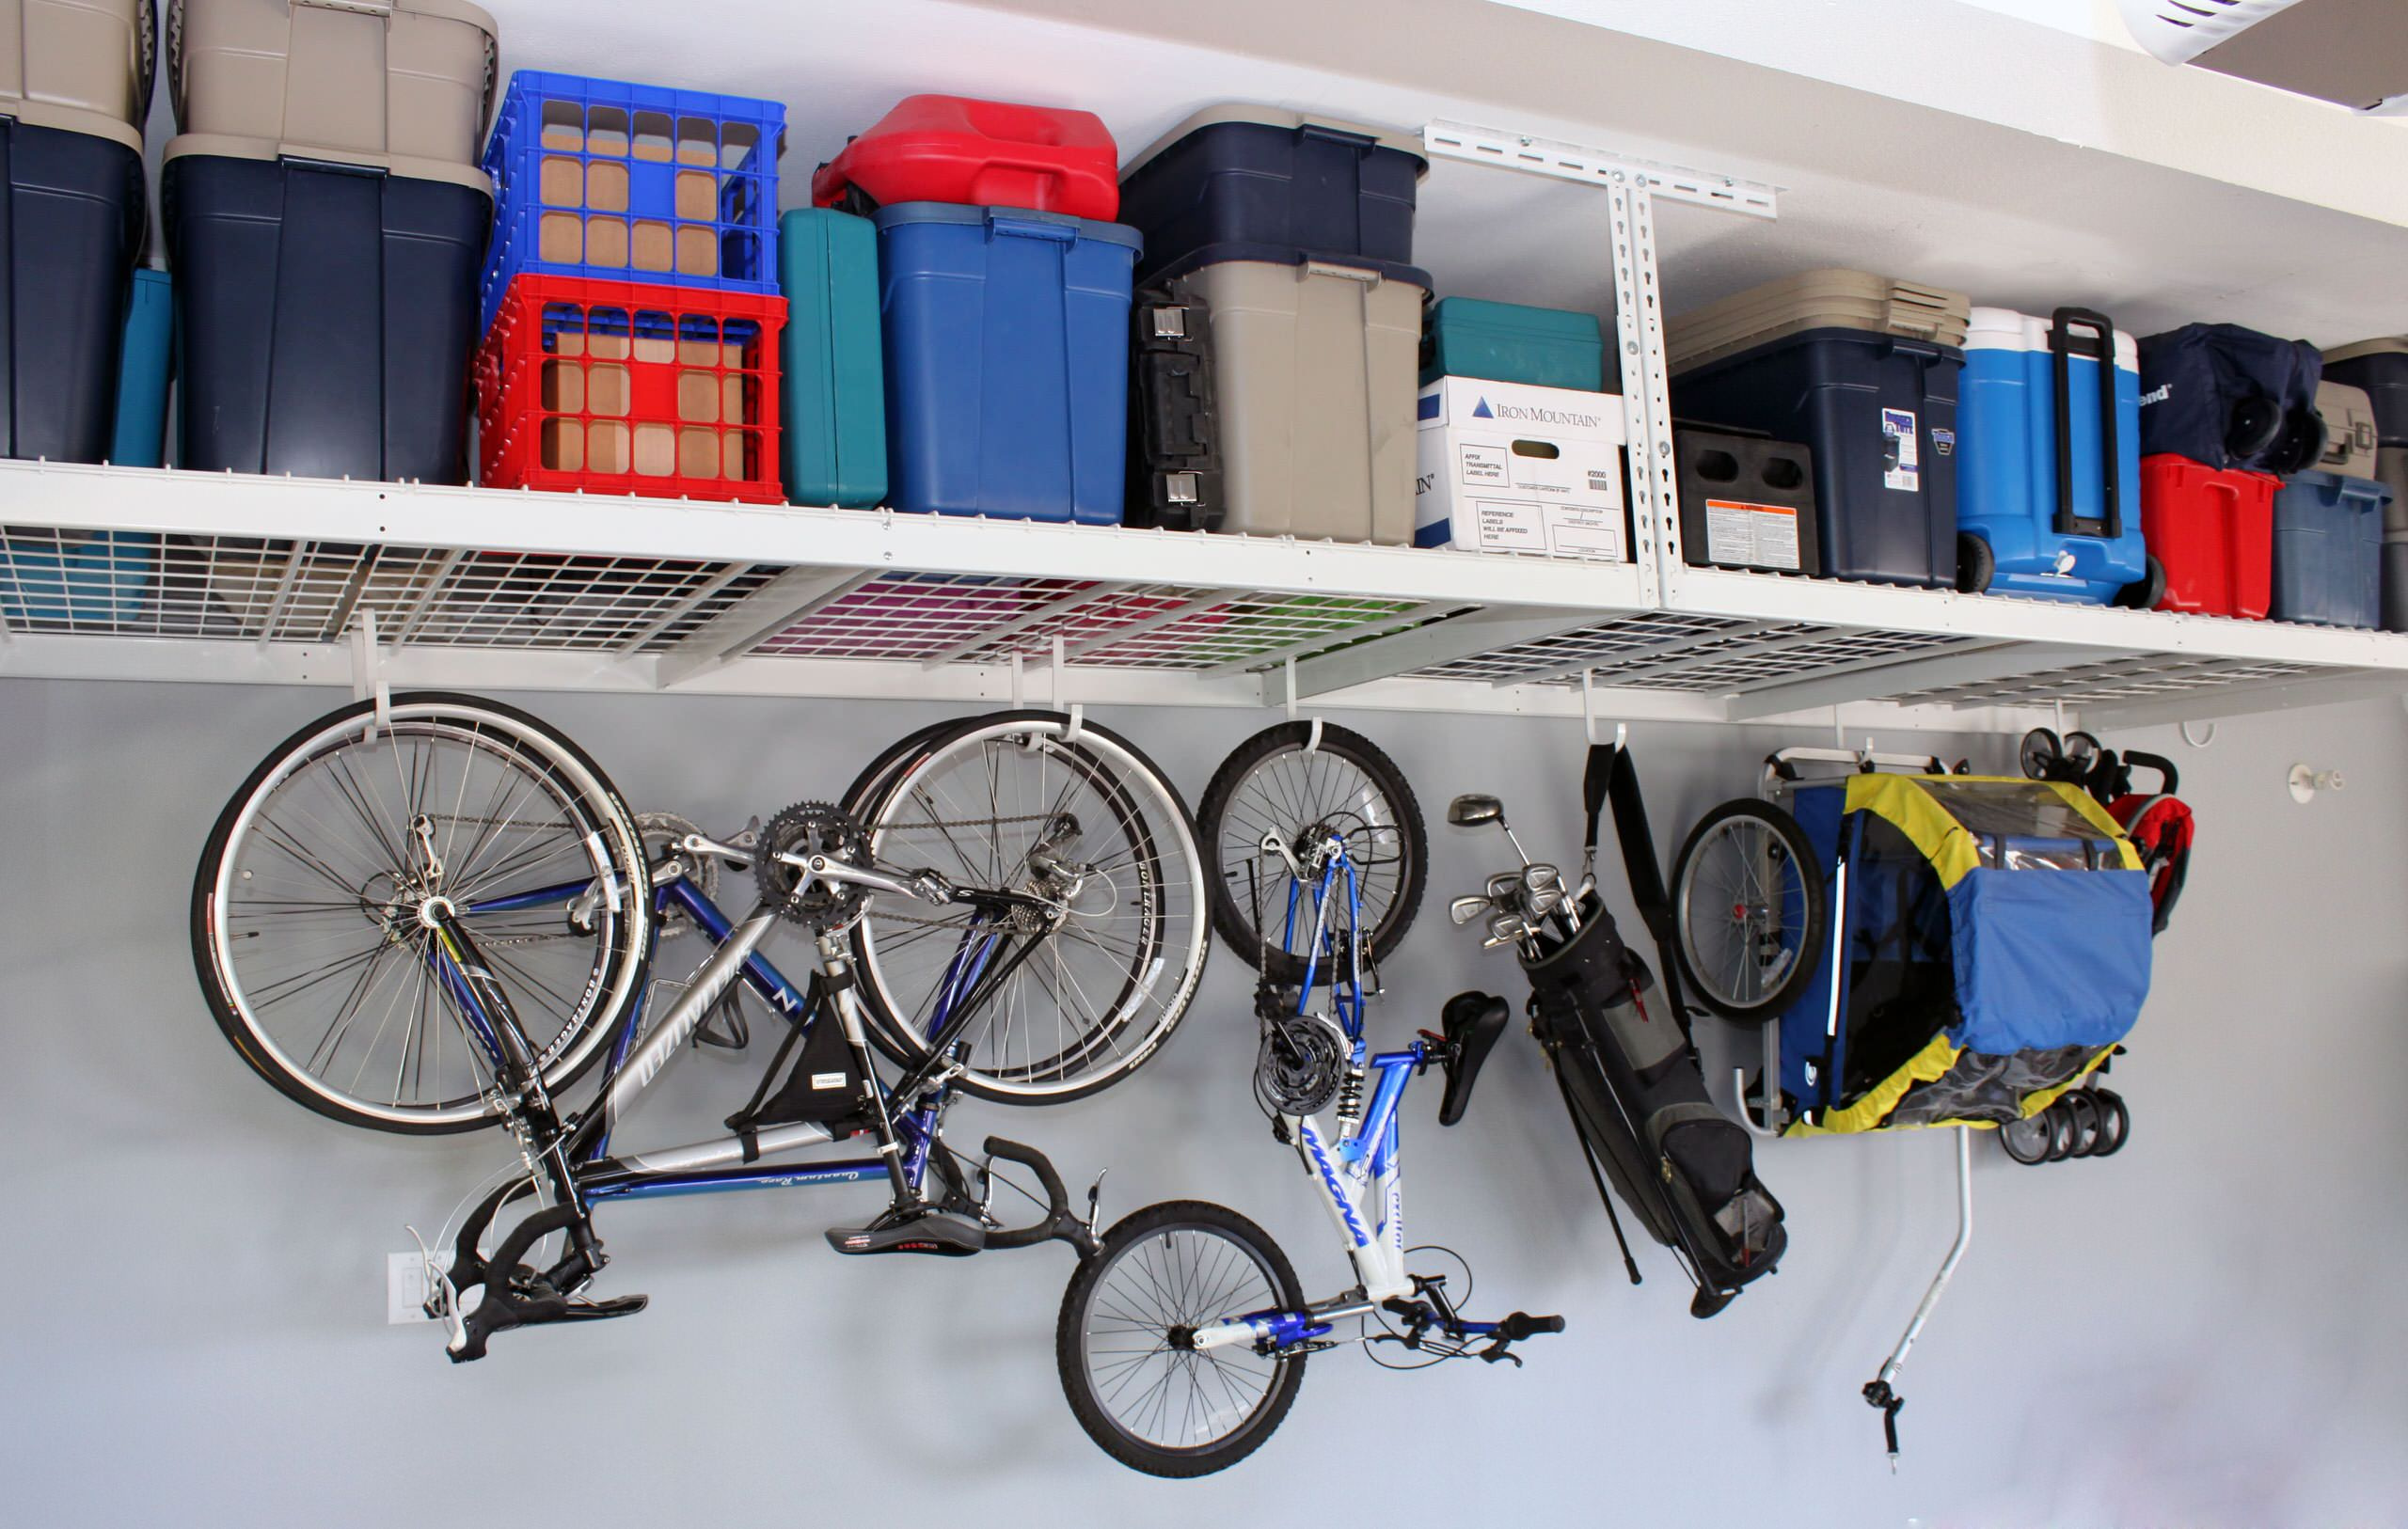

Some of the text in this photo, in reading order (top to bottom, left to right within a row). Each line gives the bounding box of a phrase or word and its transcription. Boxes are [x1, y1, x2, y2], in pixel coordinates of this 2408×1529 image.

[1497, 403, 1598, 428] IRON MOUNTAIN
[1300, 1127, 1370, 1248] MAGNA
